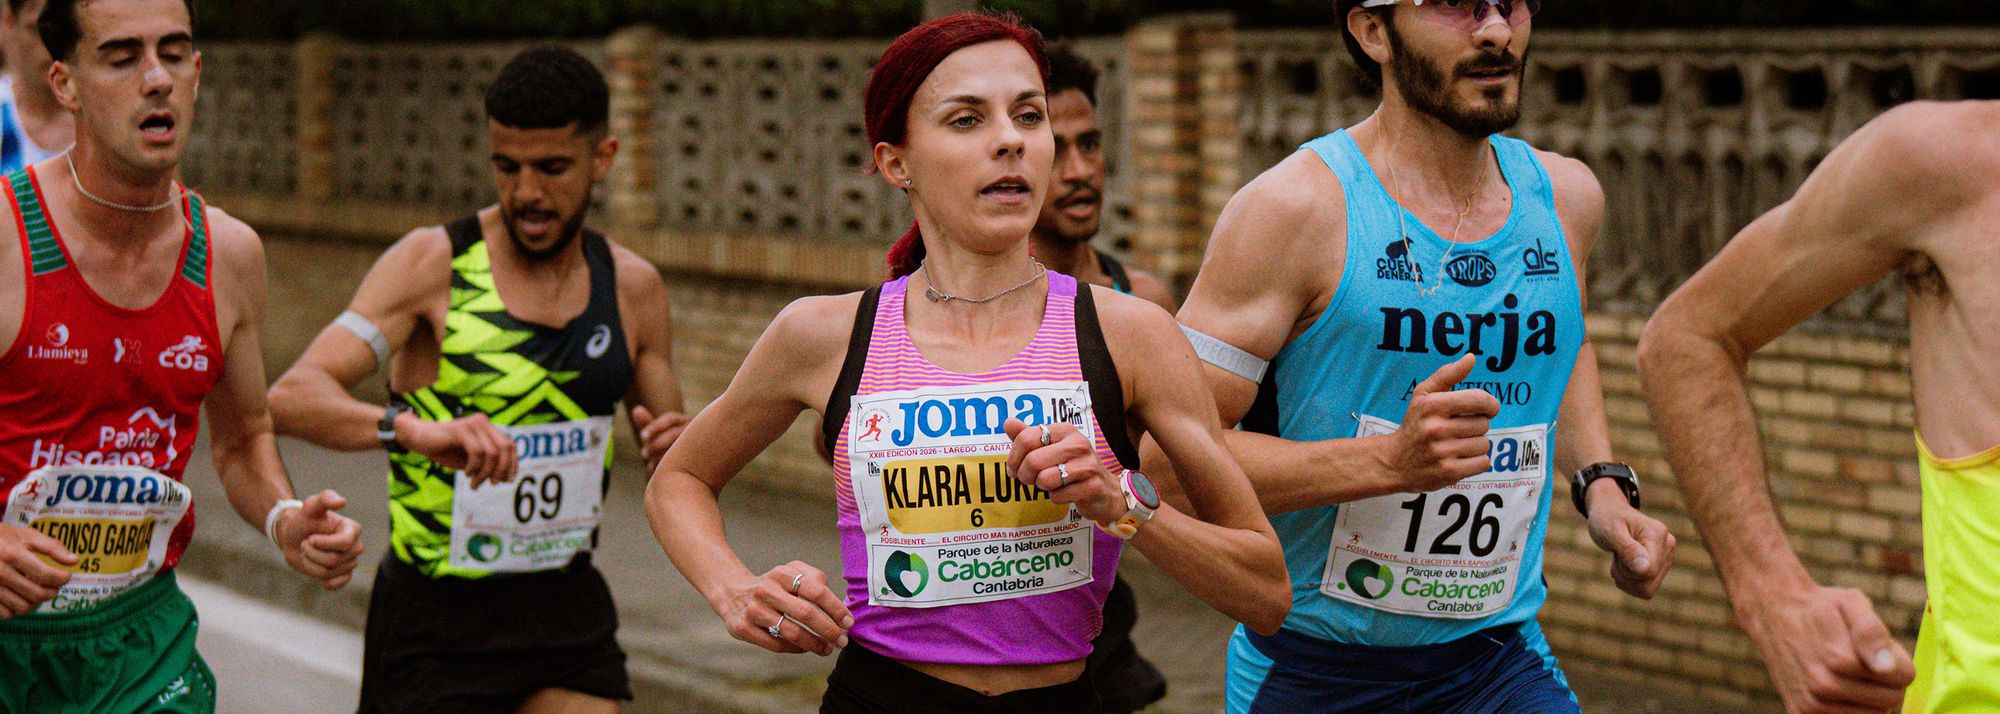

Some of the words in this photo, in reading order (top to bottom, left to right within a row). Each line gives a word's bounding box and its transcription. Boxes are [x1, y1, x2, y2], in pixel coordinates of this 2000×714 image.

[1377, 258, 1423, 275] CUEVA
[1448, 256, 1495, 281] TROPS
[1377, 293, 1556, 373] nerja
[513, 427, 587, 461] oma
[886, 449, 918, 458] EDICION
[943, 445, 977, 454] LAREDO
[513, 472, 563, 523] 69
[882, 463, 972, 510] KLARA
[970, 508, 985, 528] 6
[1401, 492, 1504, 558] 126
[953, 533, 989, 543] CIRCUITO
[990, 531, 1007, 539] MAS
[1008, 530, 1037, 538] RAPIDO
[1053, 522, 1079, 533] MUNDO
[938, 547, 981, 560] Parque
[983, 544, 999, 555] de
[1002, 543, 1012, 553] la
[1014, 536, 1074, 553] Naturaleza
[79, 558, 100, 573] 45
[937, 549, 1075, 583] Cabárceno
[1405, 565, 1442, 578] Parque
[1445, 567, 1457, 578] de
[1459, 568, 1468, 578] la
[1470, 565, 1507, 579] Naturaleza
[1410, 557, 1418, 565] EL
[1421, 558, 1450, 566] CIRCUITO
[972, 576, 1044, 595] Cantabria
[1400, 577, 1505, 600] Cabárceno
[1427, 599, 1484, 612] Cantabria
